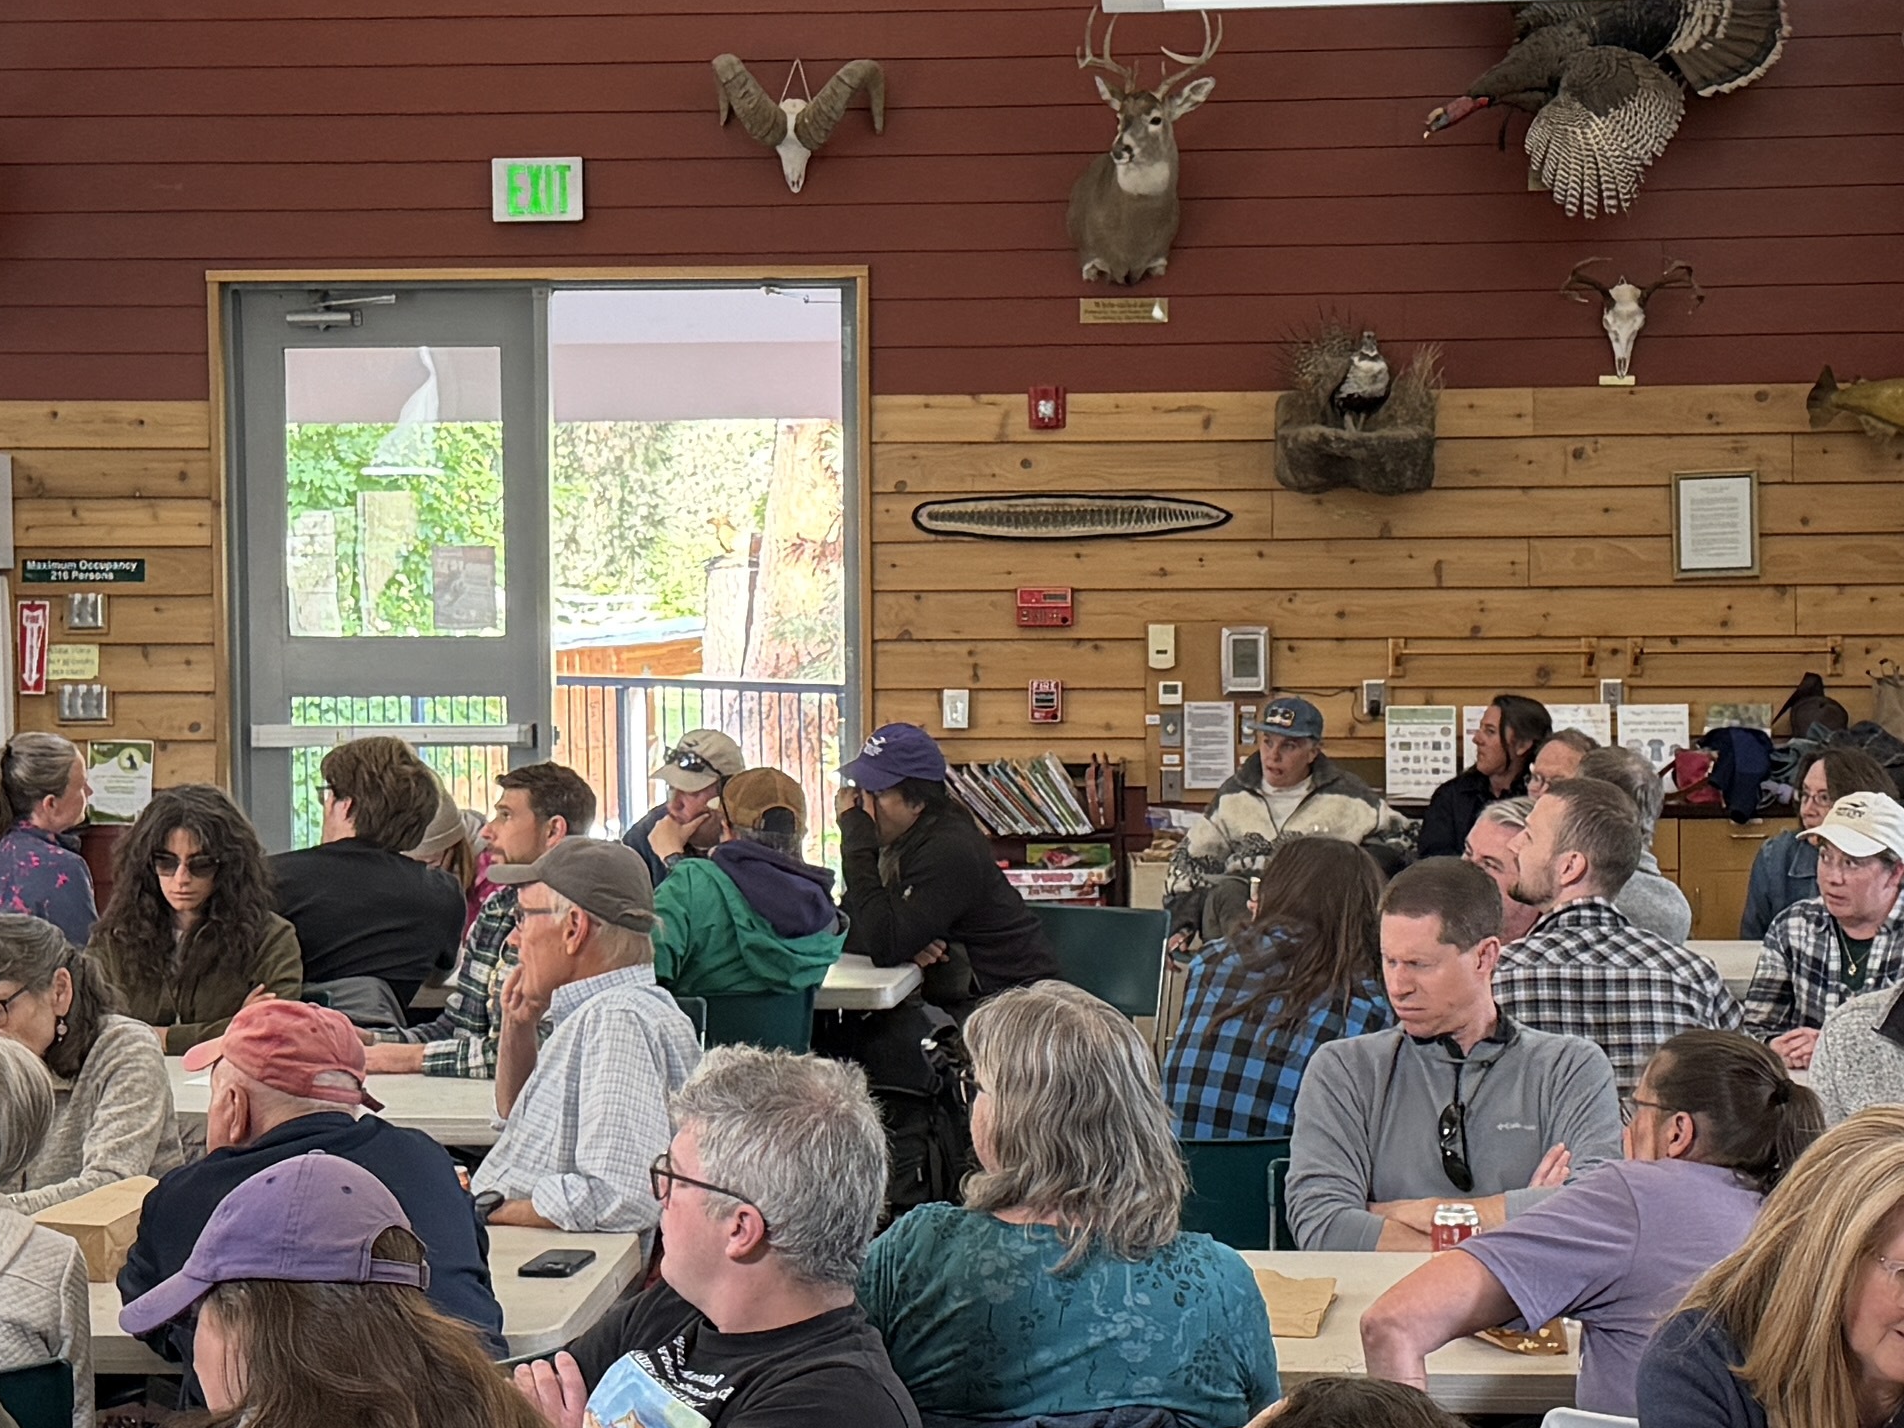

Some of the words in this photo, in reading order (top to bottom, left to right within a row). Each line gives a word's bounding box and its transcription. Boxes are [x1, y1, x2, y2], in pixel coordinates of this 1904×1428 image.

[507, 164, 571, 216] EXIT
[26, 560, 76, 570] Maximum
[79, 560, 137, 571] Occupancy
[71, 571, 114, 580] Persons
